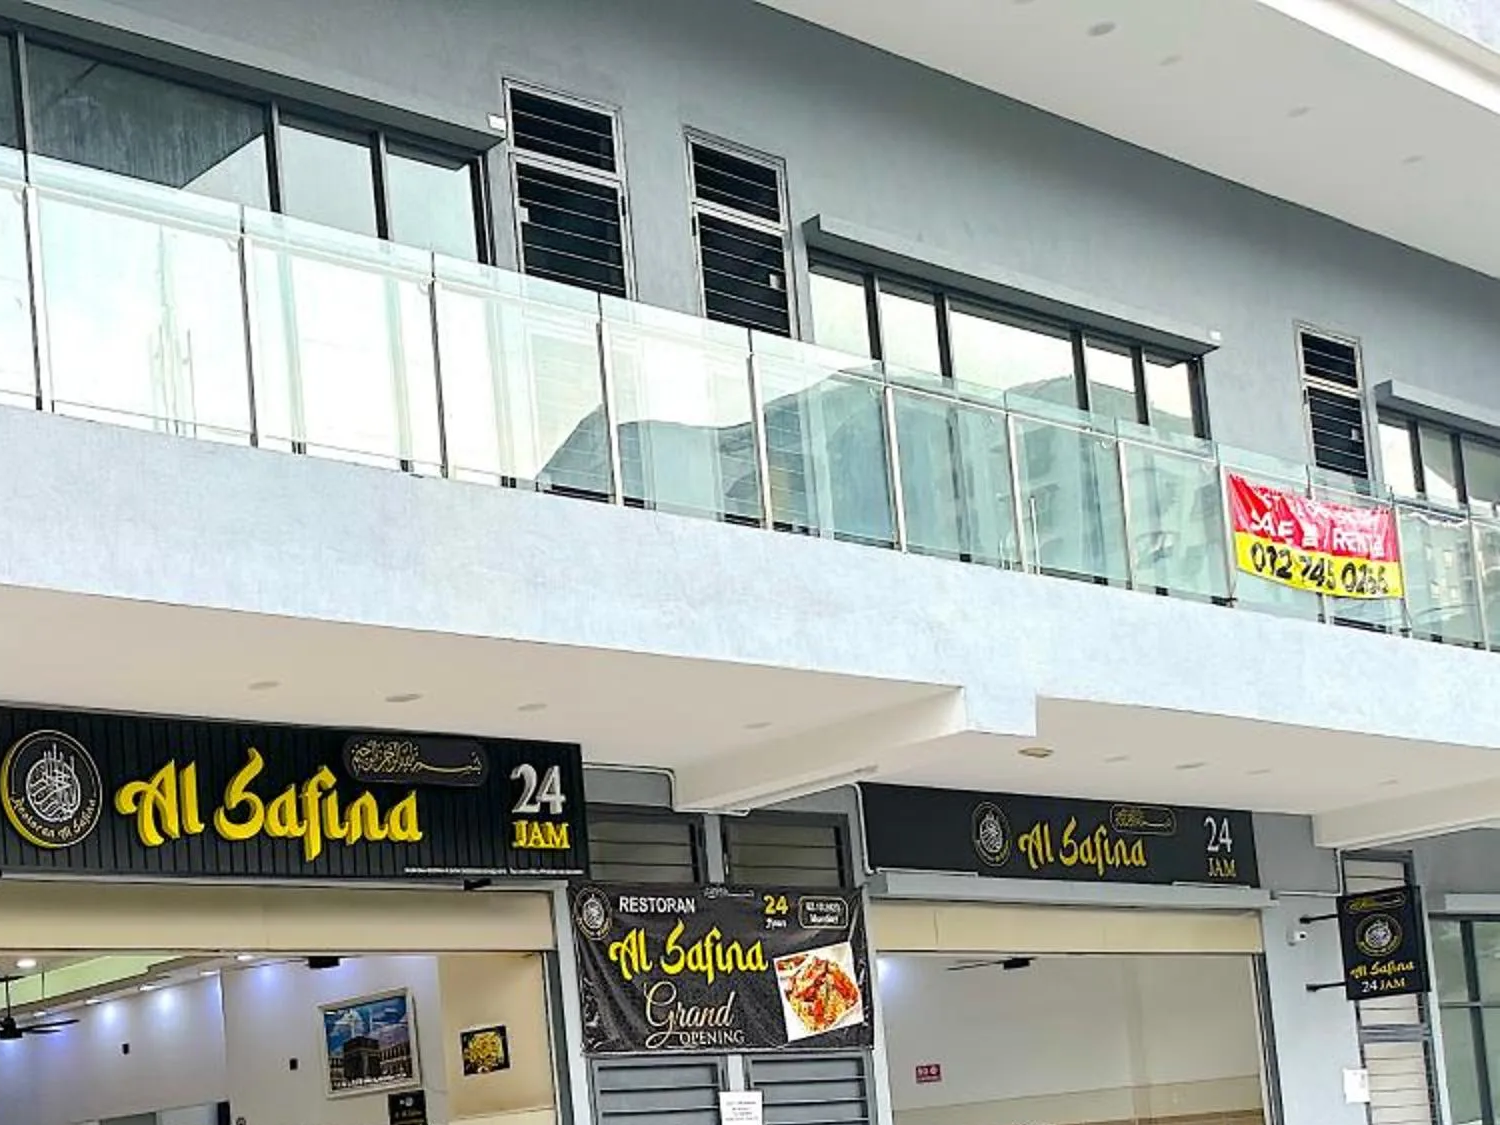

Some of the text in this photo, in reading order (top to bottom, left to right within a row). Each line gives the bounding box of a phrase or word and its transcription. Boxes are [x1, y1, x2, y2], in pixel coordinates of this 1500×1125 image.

[510, 763, 566, 814] 24
[114, 747, 423, 862] Al Safina
[511, 820, 571, 849] JAM
[1018, 816, 1147, 877] Al Safina
[1203, 815, 1233, 853] 24
[1208, 857, 1237, 878] JAM
[619, 896, 696, 914] RESTORAN
[763, 895, 788, 915] 24
[609, 927, 653, 981] Al
[660, 918, 768, 985] Safina
[1370, 959, 1415, 976] Safina
[1361, 977, 1405, 993] 24 JAM
[643, 981, 736, 1048] Grand
[680, 1029, 745, 1046] OPENING
